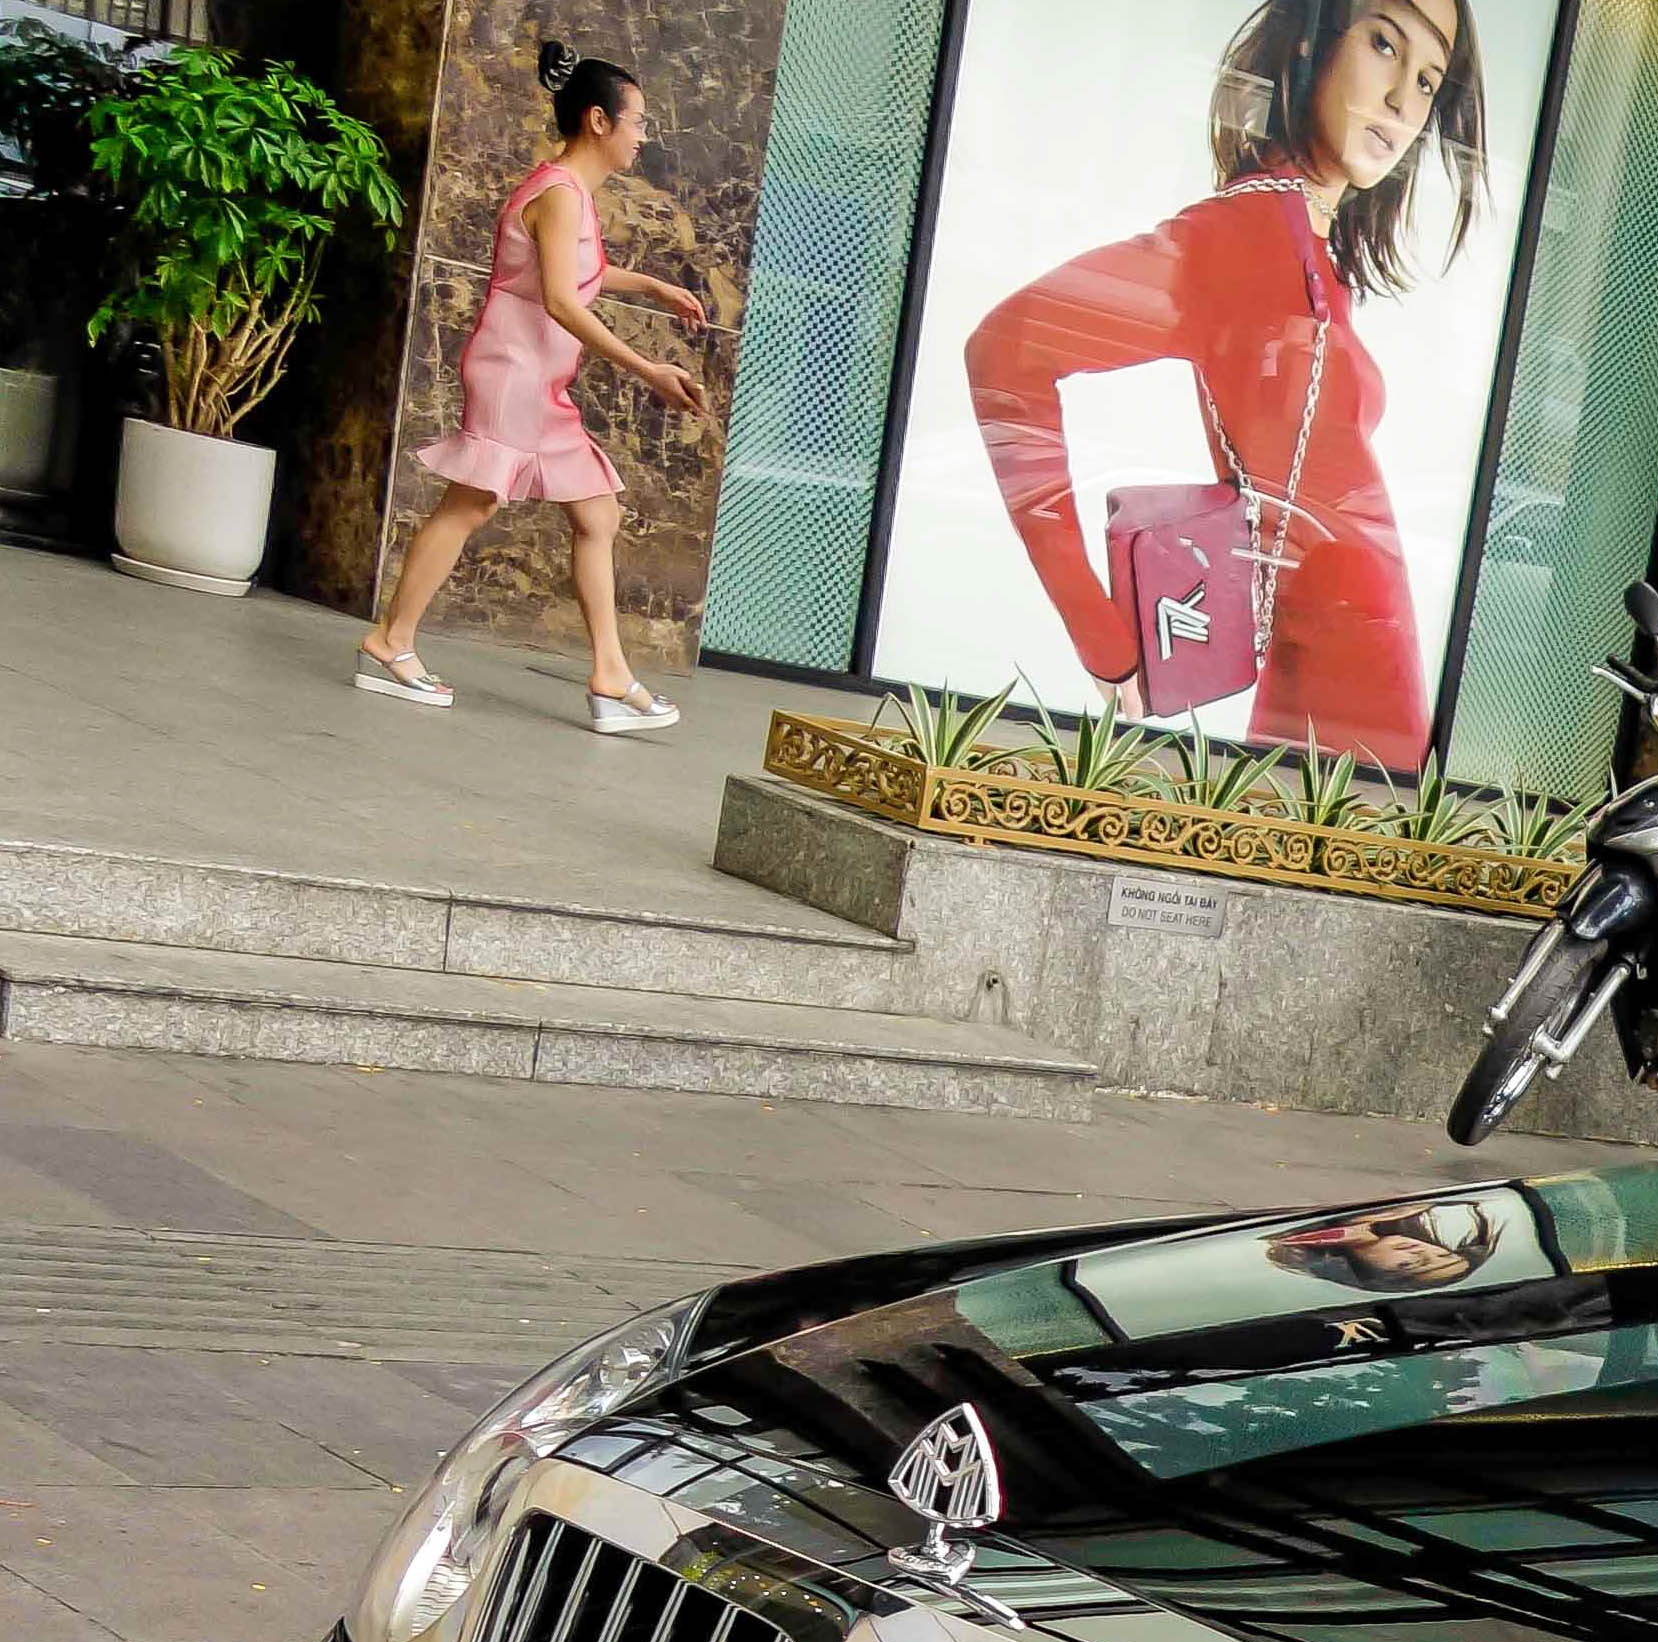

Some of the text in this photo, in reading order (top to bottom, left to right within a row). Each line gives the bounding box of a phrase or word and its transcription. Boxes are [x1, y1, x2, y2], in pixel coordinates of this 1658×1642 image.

[1121, 886, 1156, 902] KHÔNG
[1121, 905, 1214, 929] DO NOT SEAT HERE
